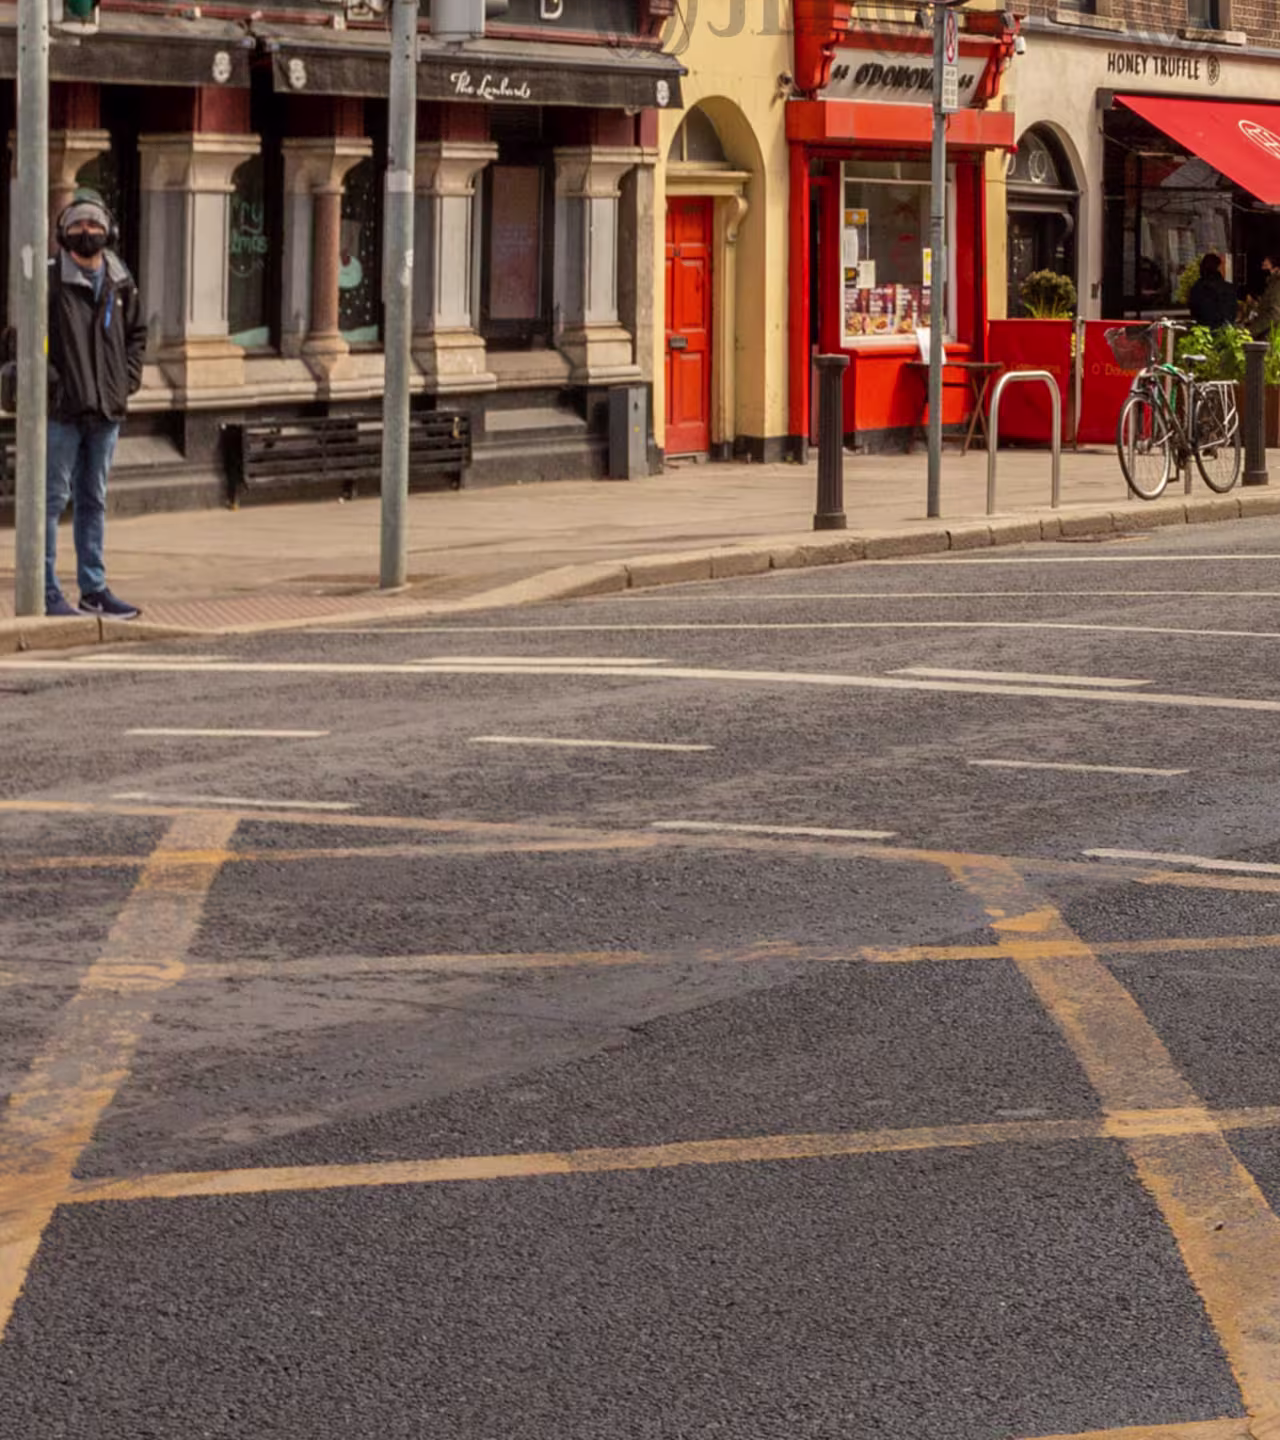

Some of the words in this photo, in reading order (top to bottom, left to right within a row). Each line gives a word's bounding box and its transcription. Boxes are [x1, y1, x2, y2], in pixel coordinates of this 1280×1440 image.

[1107, 51, 1149, 76] HONEY
[1152, 56, 1201, 80] TRUFFLE
[450, 70, 475, 95] The
